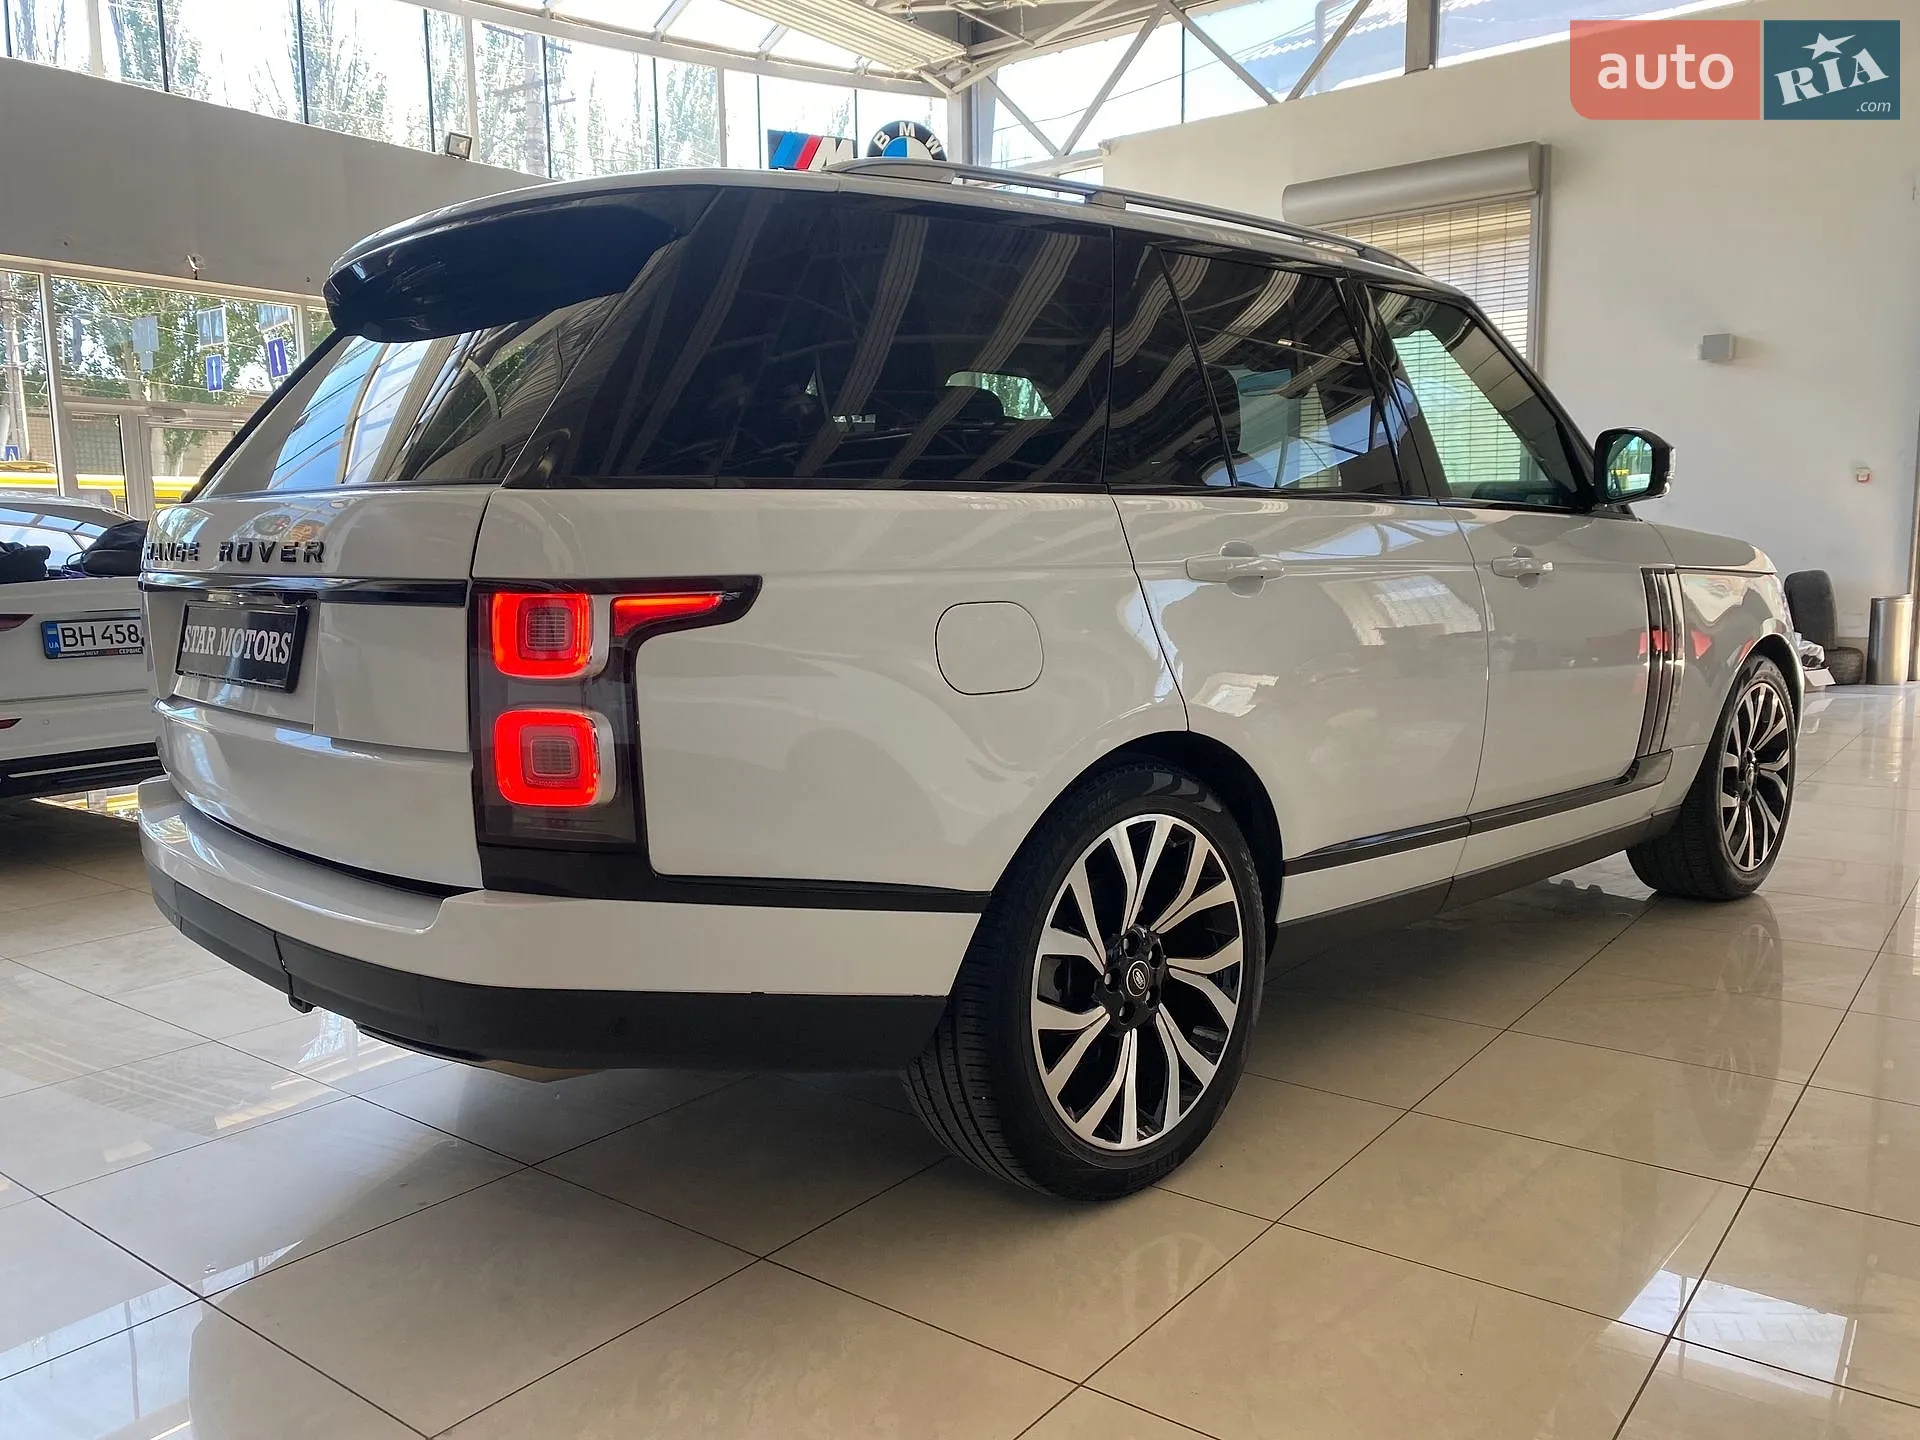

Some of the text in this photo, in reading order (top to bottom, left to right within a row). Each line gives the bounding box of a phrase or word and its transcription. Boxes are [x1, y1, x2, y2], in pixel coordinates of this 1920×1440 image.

[873, 121, 943, 154] BMW
[218, 541, 325, 564] ROVER
[48, 641, 59, 649] UA
[60, 625, 97, 648] BH
[182, 624, 292, 665] STAR MOTORS
